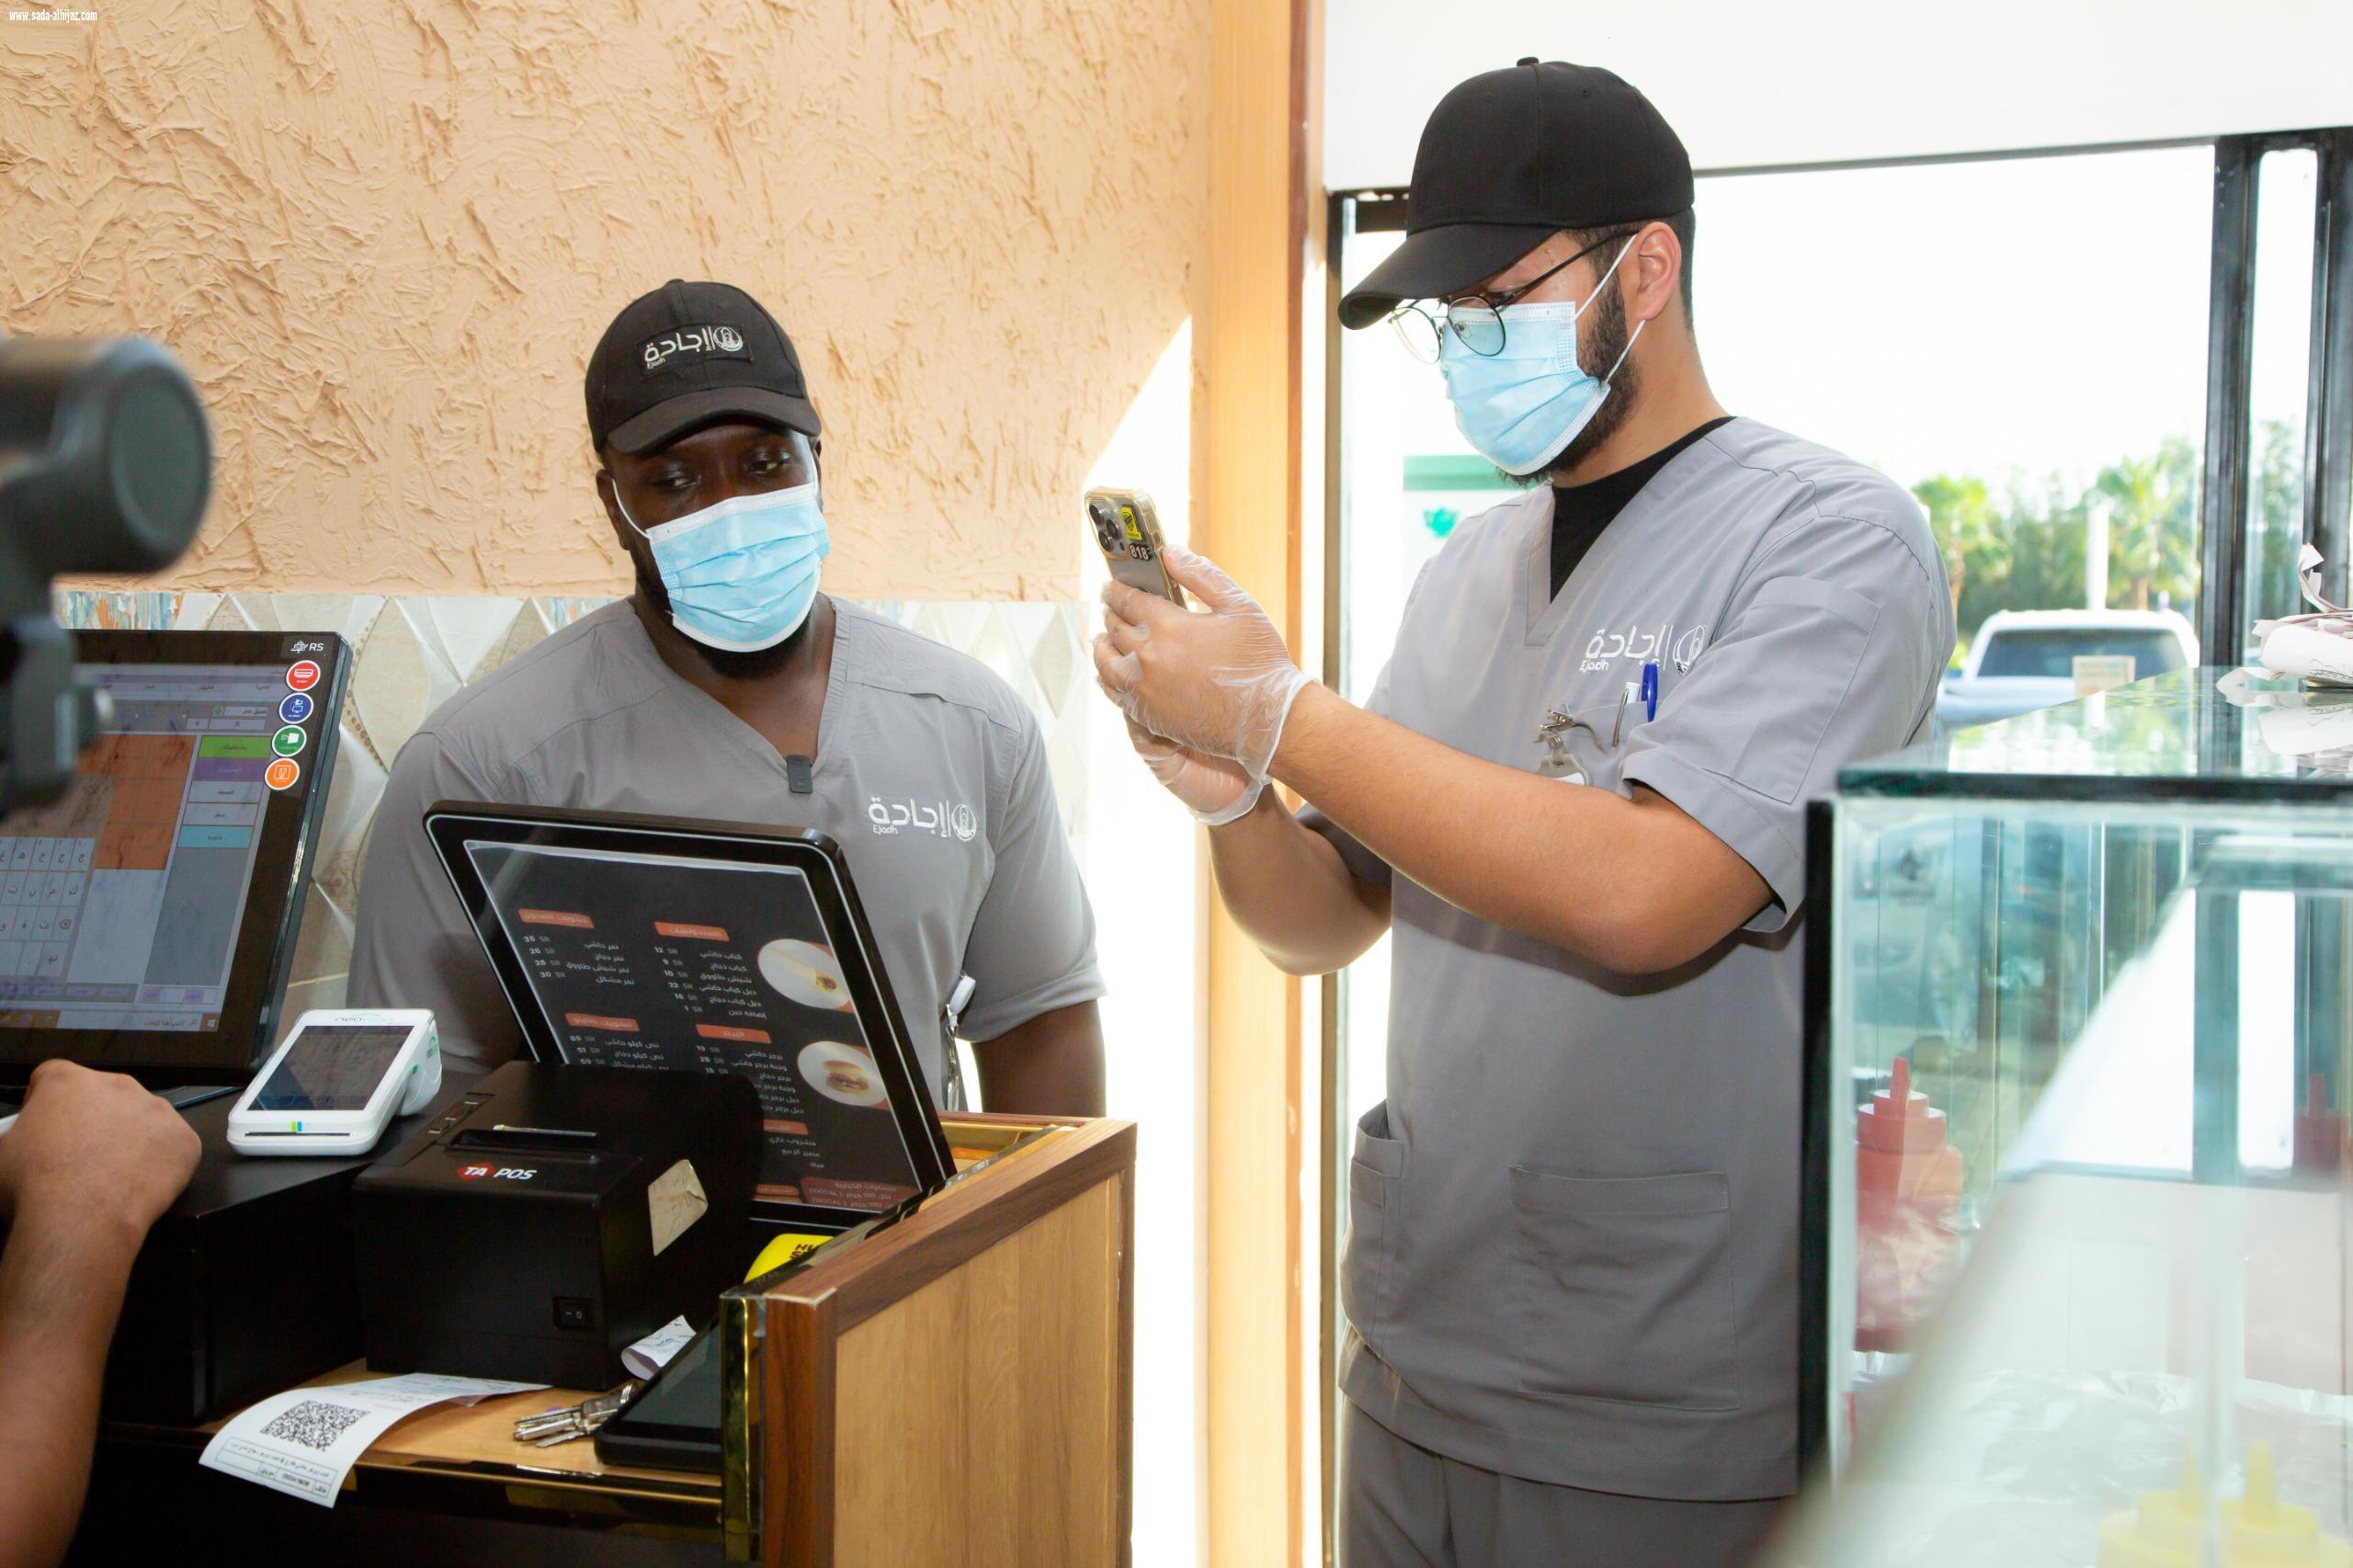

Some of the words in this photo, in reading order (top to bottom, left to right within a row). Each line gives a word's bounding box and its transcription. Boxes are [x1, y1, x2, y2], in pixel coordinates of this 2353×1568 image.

[1130, 545, 1149, 561] 818
[309, 643, 324, 652] RS
[1586, 624, 1665, 667] إجادة
[1579, 660, 1609, 674] Ejadh
[868, 796, 948, 837] إجادة
[872, 824, 898, 835] Ejadh
[464, 1166, 488, 1176] TA
[494, 1168, 537, 1179] POS
